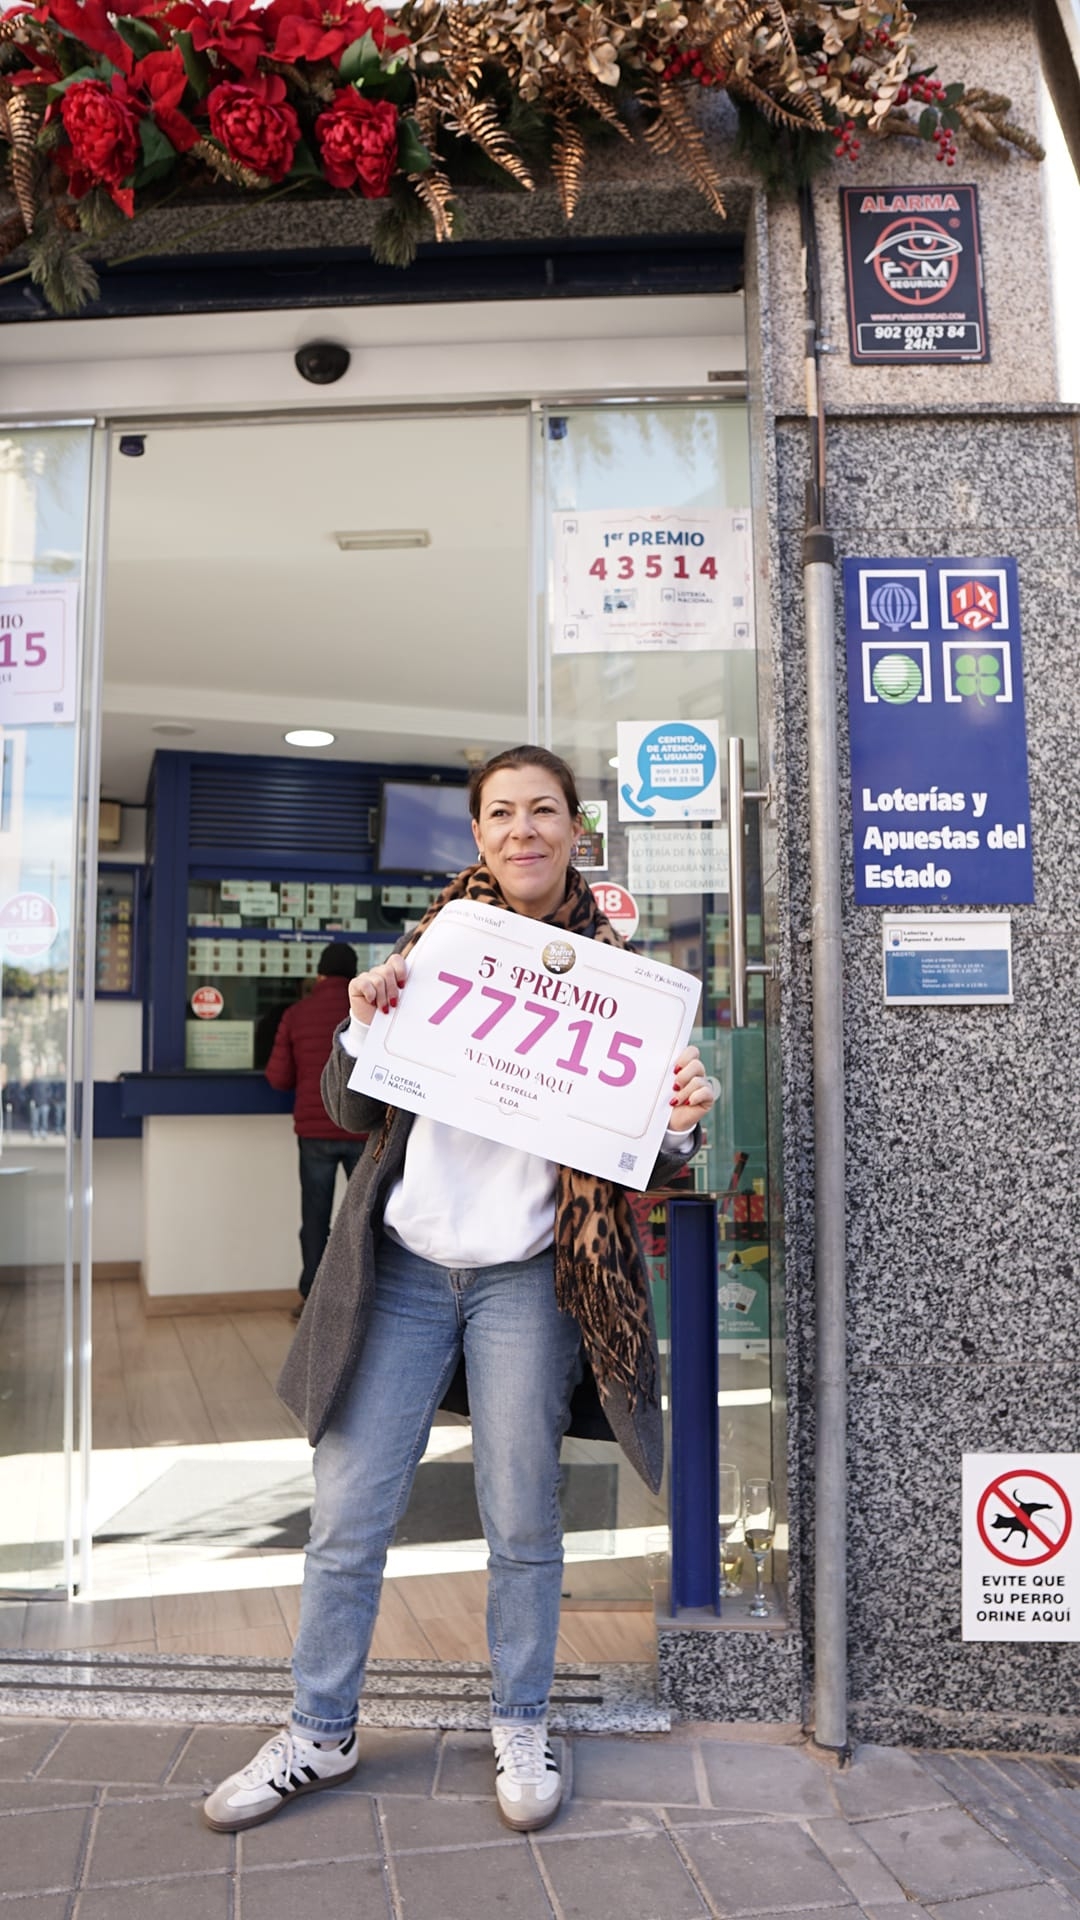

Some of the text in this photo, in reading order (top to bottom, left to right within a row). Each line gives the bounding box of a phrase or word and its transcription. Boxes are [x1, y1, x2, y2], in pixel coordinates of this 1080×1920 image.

[860, 194, 960, 213] ALARMA
[882, 260, 949, 279] FYM
[889, 280, 948, 289] SEGURIDAD
[875, 325, 965, 339] 902 00 83 84
[904, 338, 937, 350] 24H.
[603, 531, 705, 547] 1er PREMIO
[658, 735, 695, 744] CENTRO
[646, 742, 707, 753] DE ATENCIÓN
[650, 752, 704, 761] AL USUARIO
[862, 786, 988, 818] Loterías y
[650, 832, 697, 841] RESERVAS
[700, 832, 713, 840] DE
[863, 824, 1026, 856] Apuestas del
[673, 848, 686, 856] DE
[865, 863, 951, 888] Estado
[659, 880, 671, 888] DE
[510, 965, 618, 1020] PREMIO
[428, 970, 643, 1088] 77715
[464, 1047, 574, 1096] VENDIDO AQUÍ
[390, 1073, 421, 1090] LOTERÍA
[387, 1081, 427, 1099] NACIONAL
[489, 1079, 538, 1101] LA ESTRELLA
[499, 1096, 520, 1109] ELDA
[982, 1575, 1065, 1588] EVITE QUE
[983, 1593, 1064, 1604] SU PERRO
[976, 1607, 1070, 1622] ORINE AQUÍ
